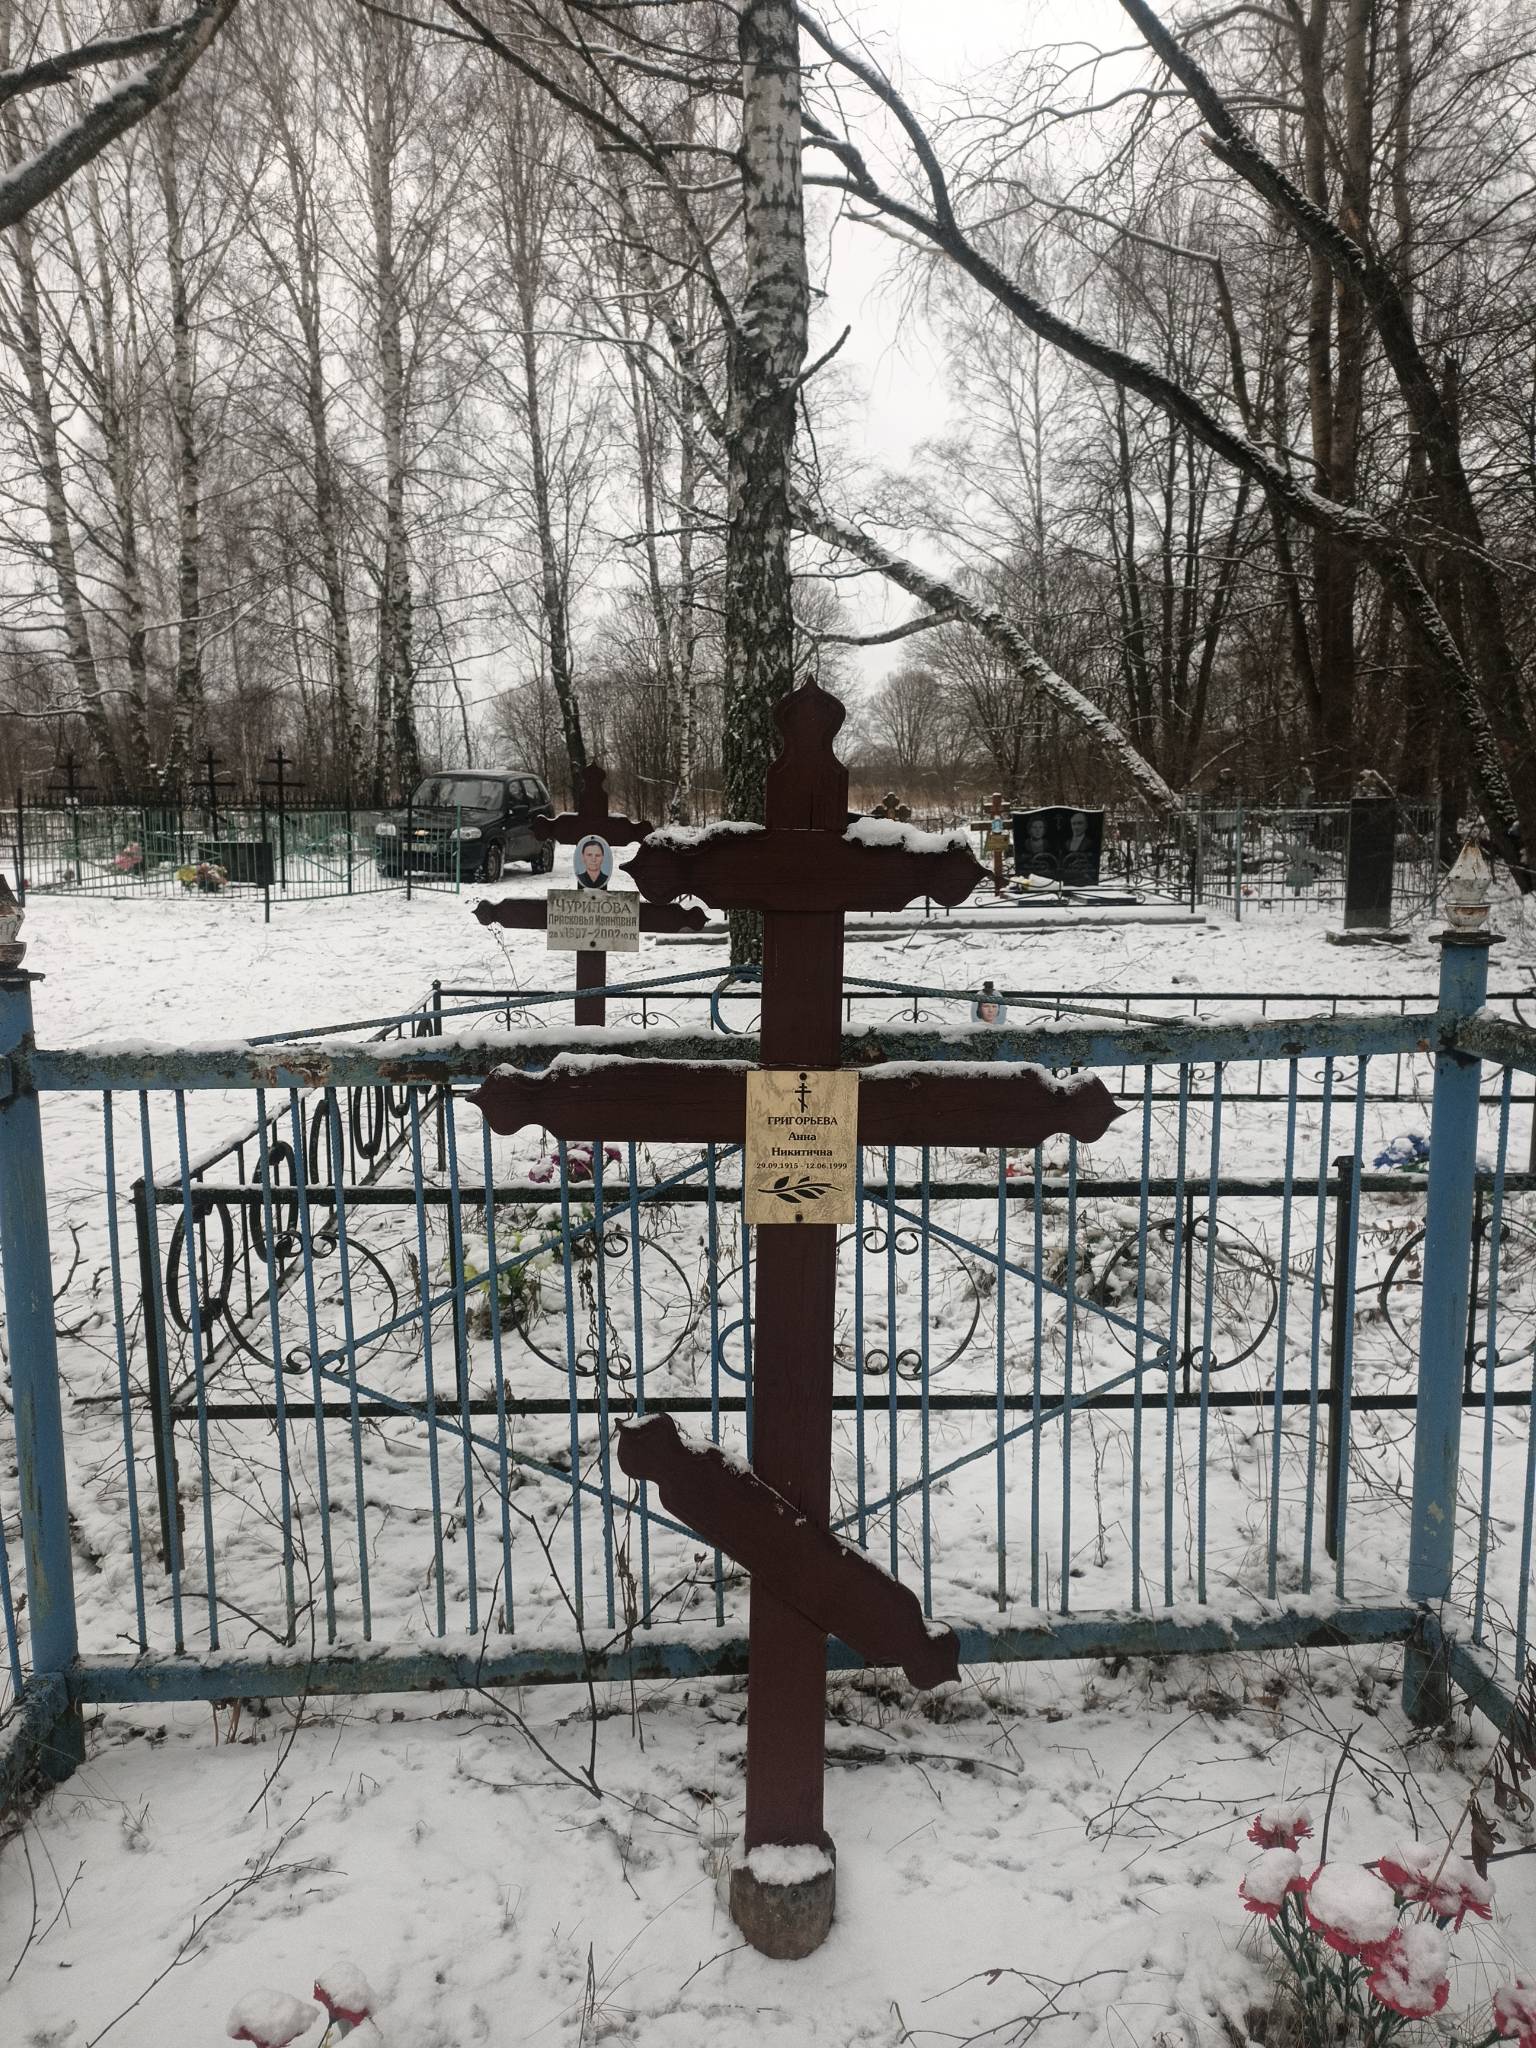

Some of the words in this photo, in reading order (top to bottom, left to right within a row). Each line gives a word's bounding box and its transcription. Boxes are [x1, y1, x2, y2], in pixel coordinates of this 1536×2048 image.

[556, 898, 632, 914] ЧУРИЛОВА
[767, 1116, 838, 1125] ГРИГОРЬЕВА
[788, 1132, 816, 1141] Анна
[771, 1147, 833, 1156] Никитична
[756, 1162, 798, 1170] 29.09.1915
[806, 1162, 848, 1170] 12.06.1999
